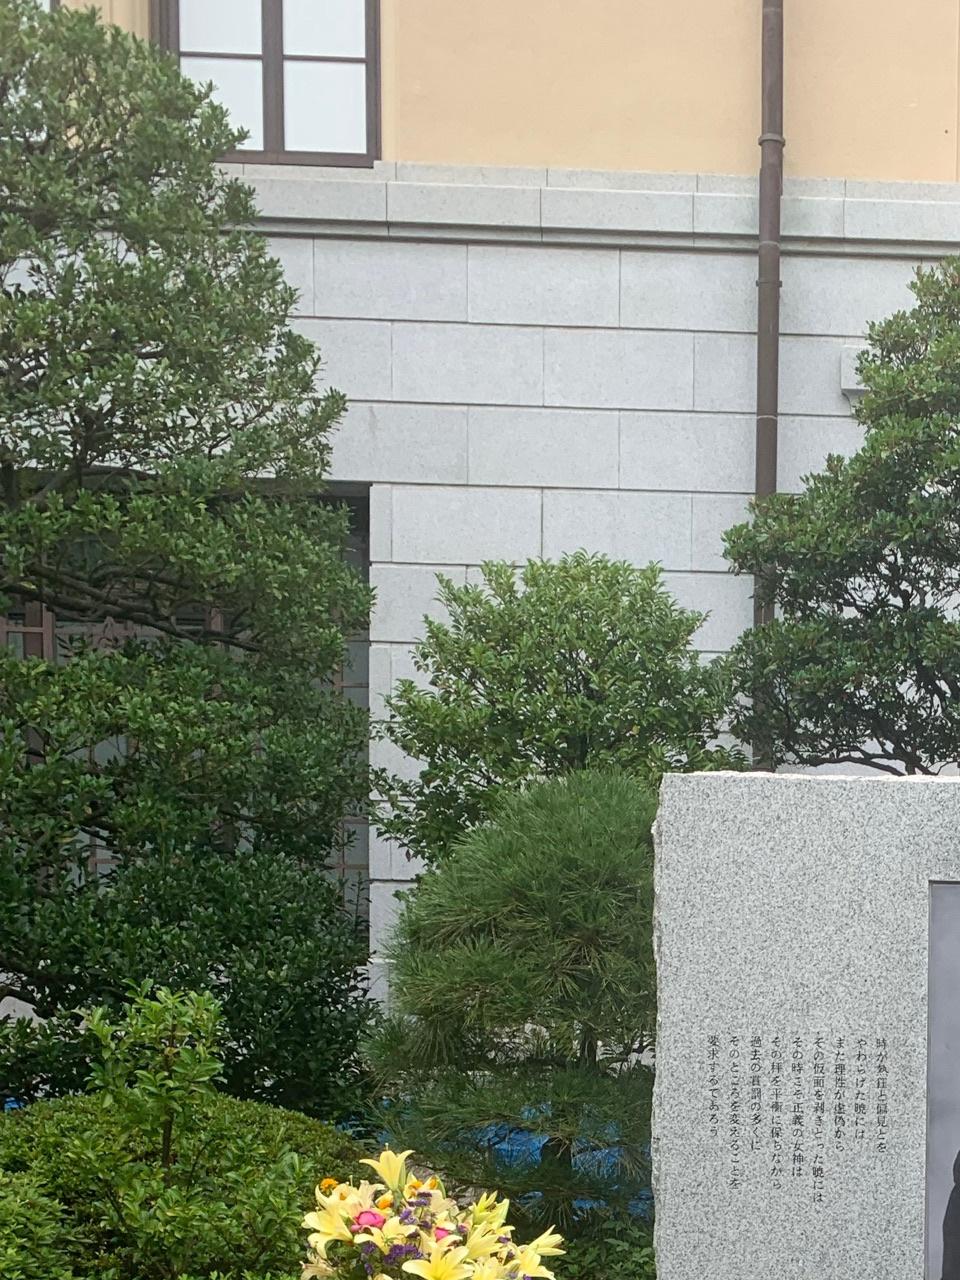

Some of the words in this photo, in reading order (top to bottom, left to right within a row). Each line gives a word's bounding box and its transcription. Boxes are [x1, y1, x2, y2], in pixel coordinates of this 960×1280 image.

[854, 1038, 868, 1140] やわらげた暁には
[876, 1037, 889, 1153] 時が熱狂と偏見とを
